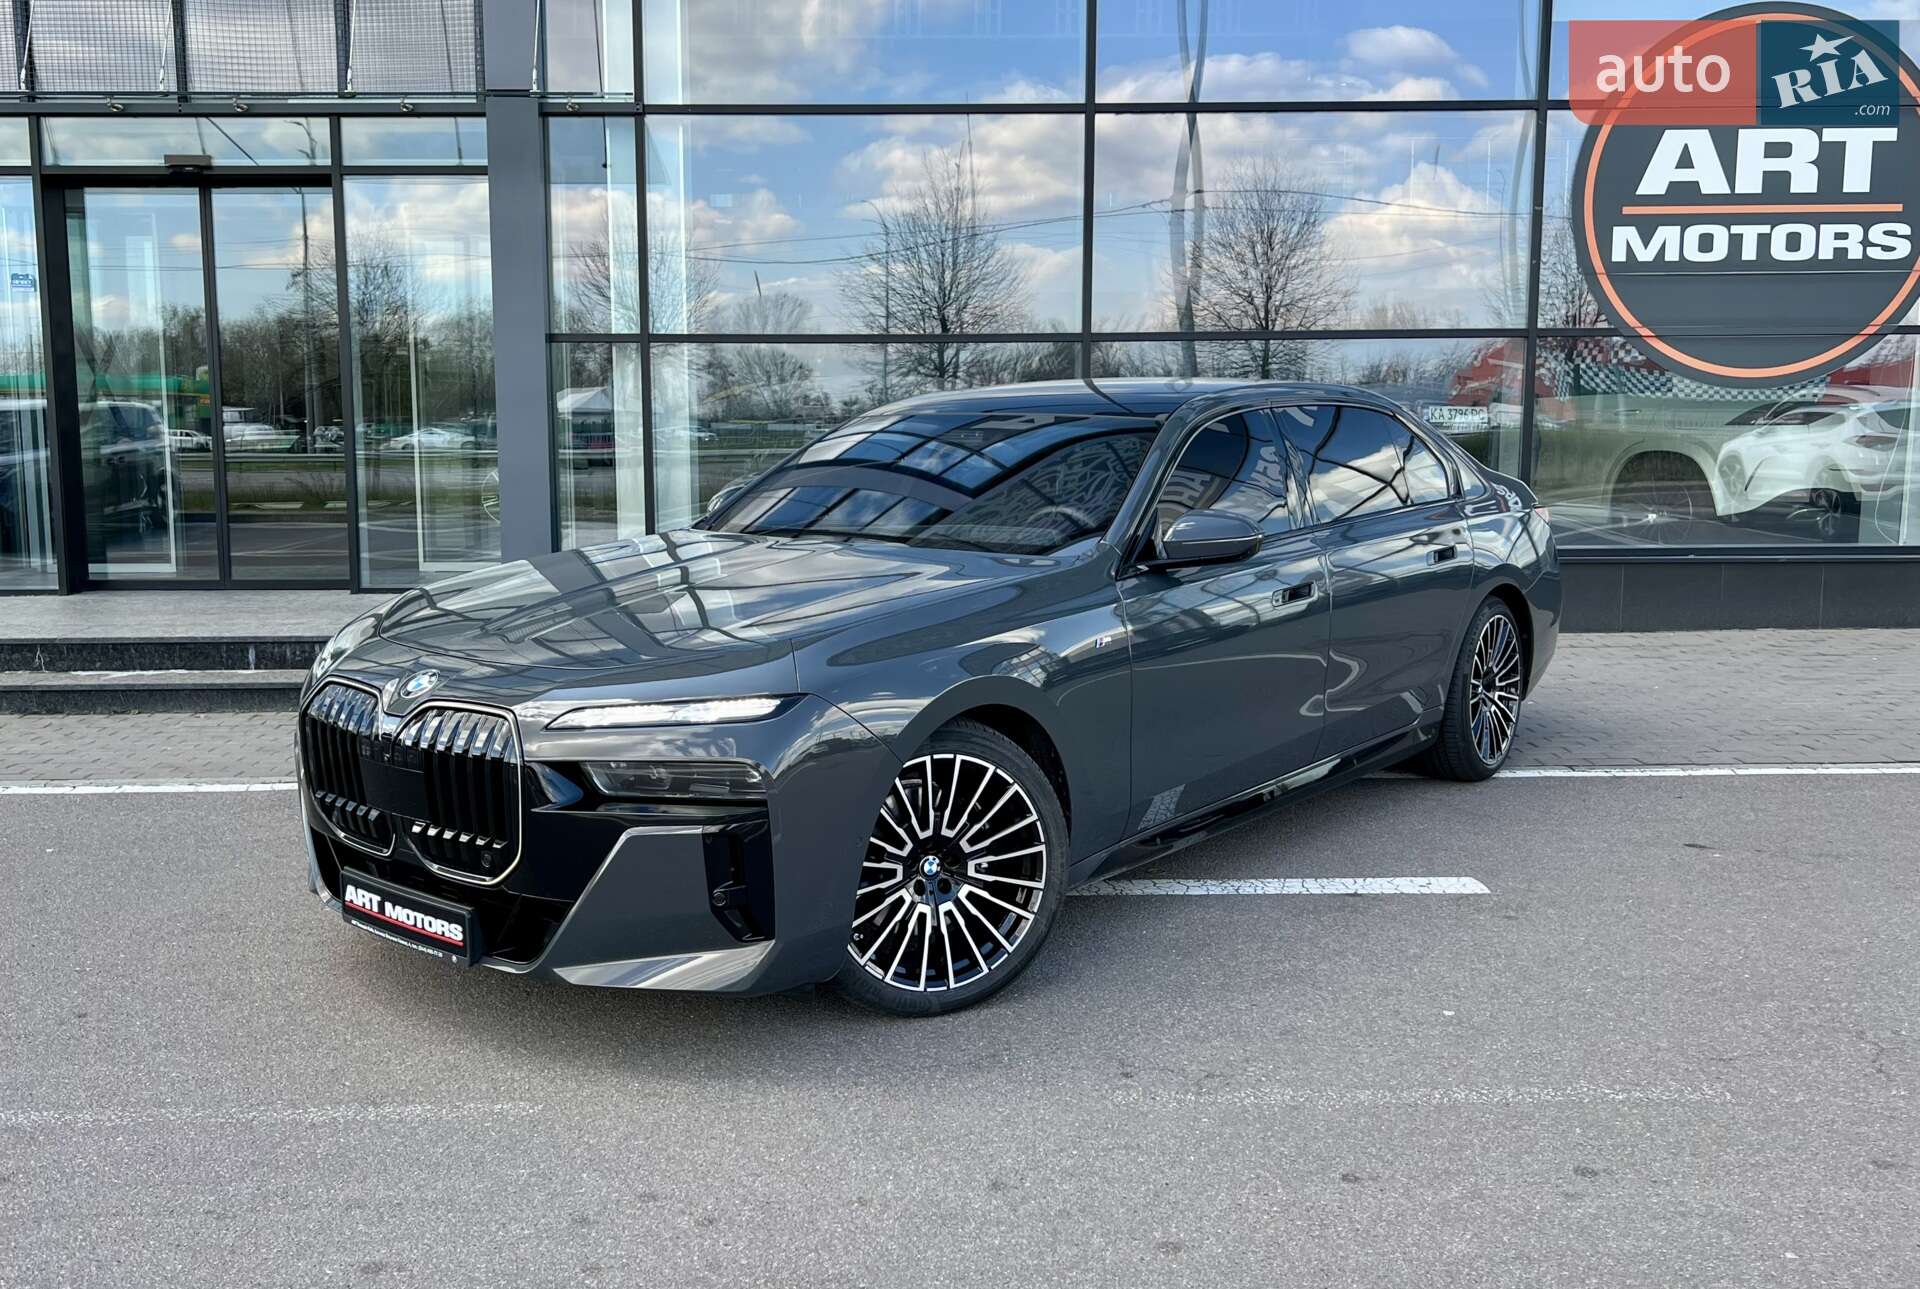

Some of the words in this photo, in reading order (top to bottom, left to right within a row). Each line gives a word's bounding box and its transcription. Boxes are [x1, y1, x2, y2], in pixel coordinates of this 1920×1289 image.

[1635, 127, 1898, 195] ART
[1611, 222, 1912, 263] MOTORS
[1430, 408, 1444, 420] KA
[344, 884, 381, 913] ART
[384, 901, 464, 941] MOTORS
